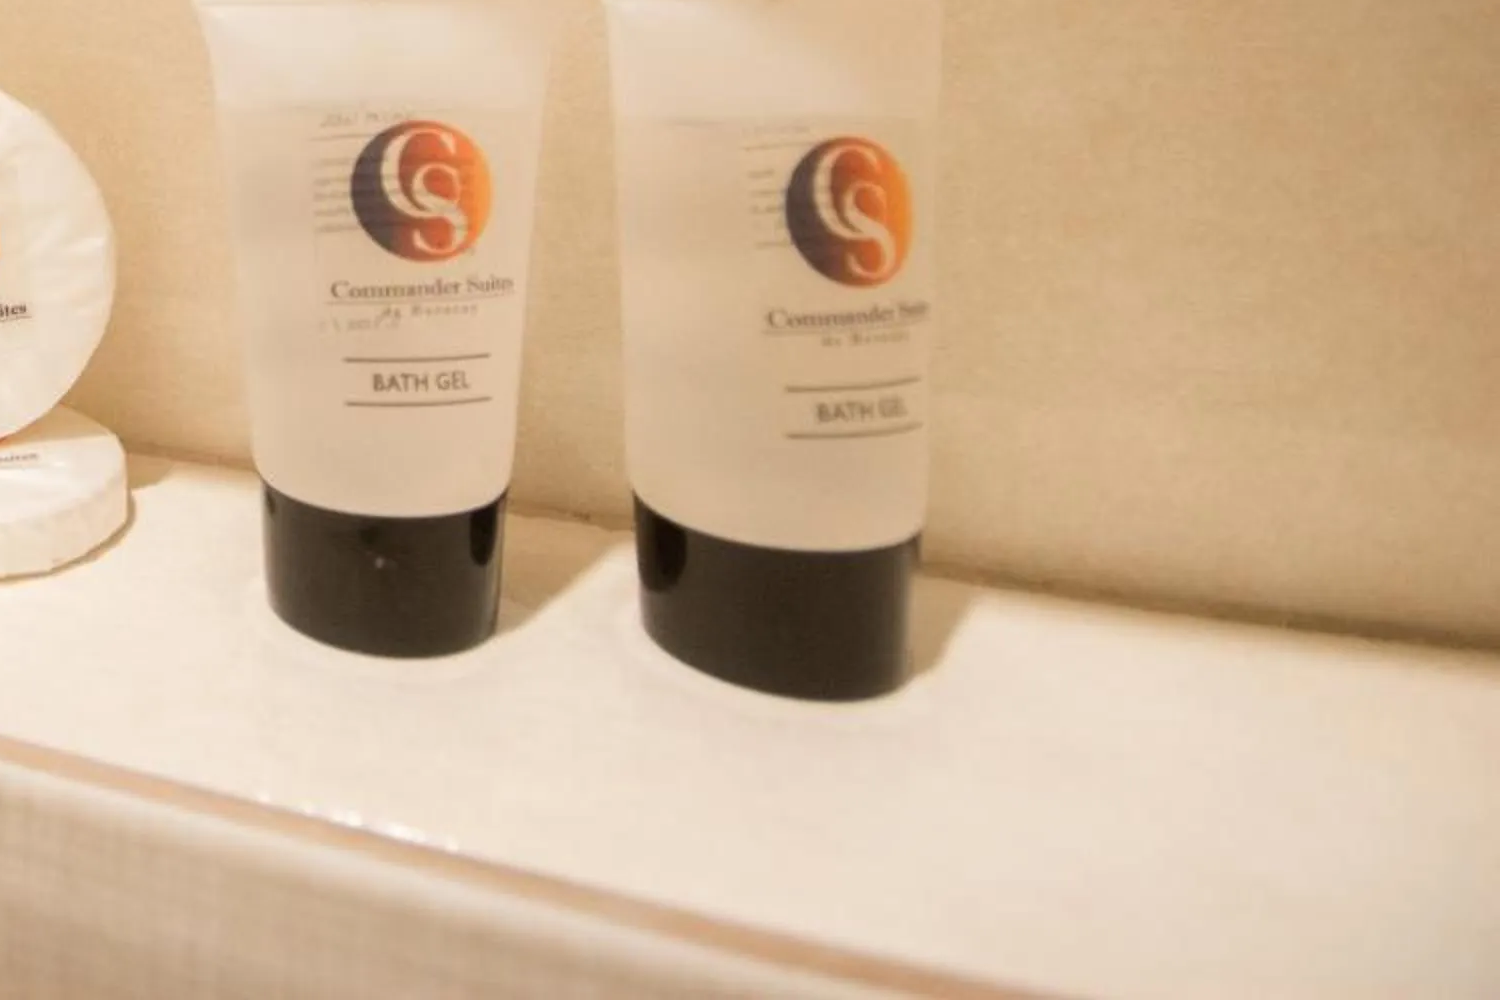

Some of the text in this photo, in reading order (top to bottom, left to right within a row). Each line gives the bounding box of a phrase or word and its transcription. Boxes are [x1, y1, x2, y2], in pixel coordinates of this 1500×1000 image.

[330, 275, 514, 299] Commander Suites
[766, 307, 893, 328] Commander
[372, 370, 470, 392] BATH GEL
[816, 402, 875, 422] BATH
